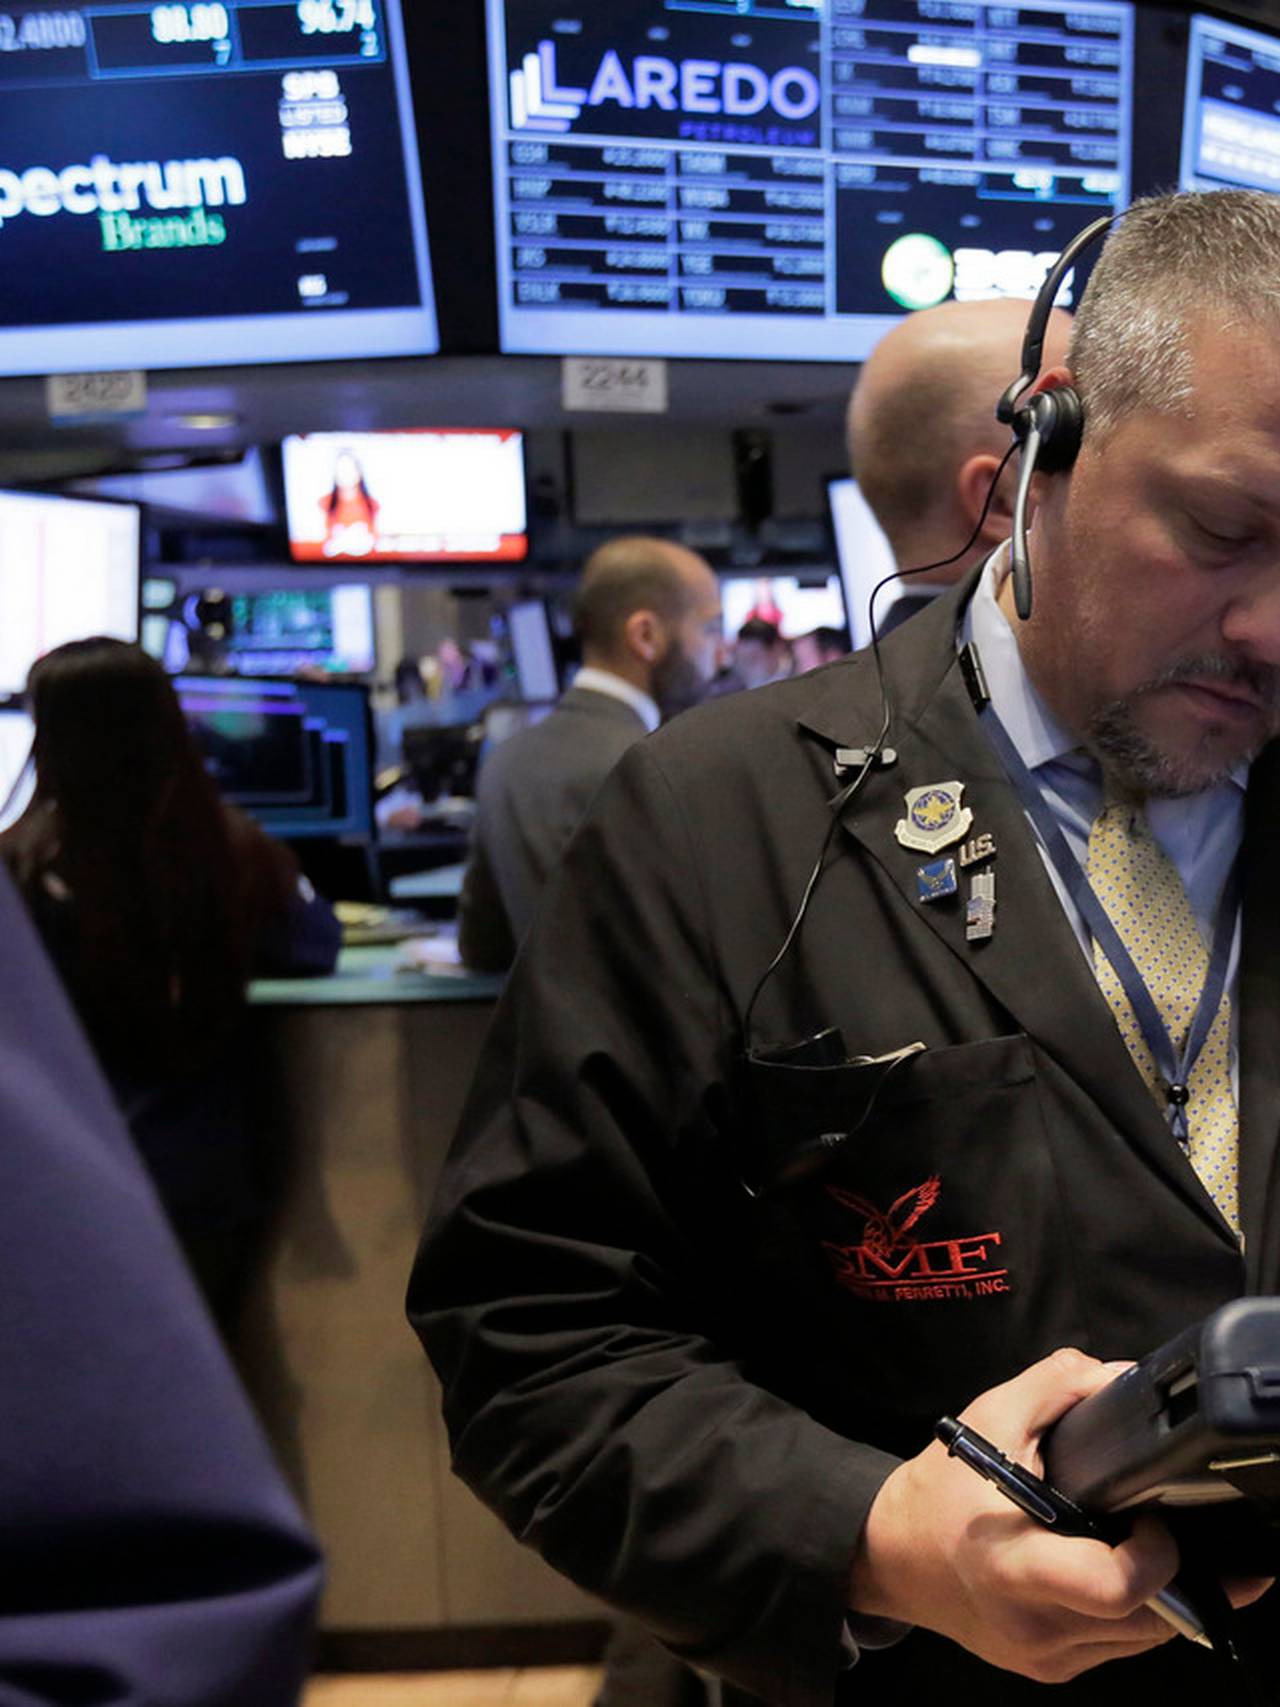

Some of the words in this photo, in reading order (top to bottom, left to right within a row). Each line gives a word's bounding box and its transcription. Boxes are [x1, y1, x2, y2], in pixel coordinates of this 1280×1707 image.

[537, 39, 820, 120] LAREDO
[100, 205, 227, 251] Brands
[975, 1278, 1011, 1296] INC.
